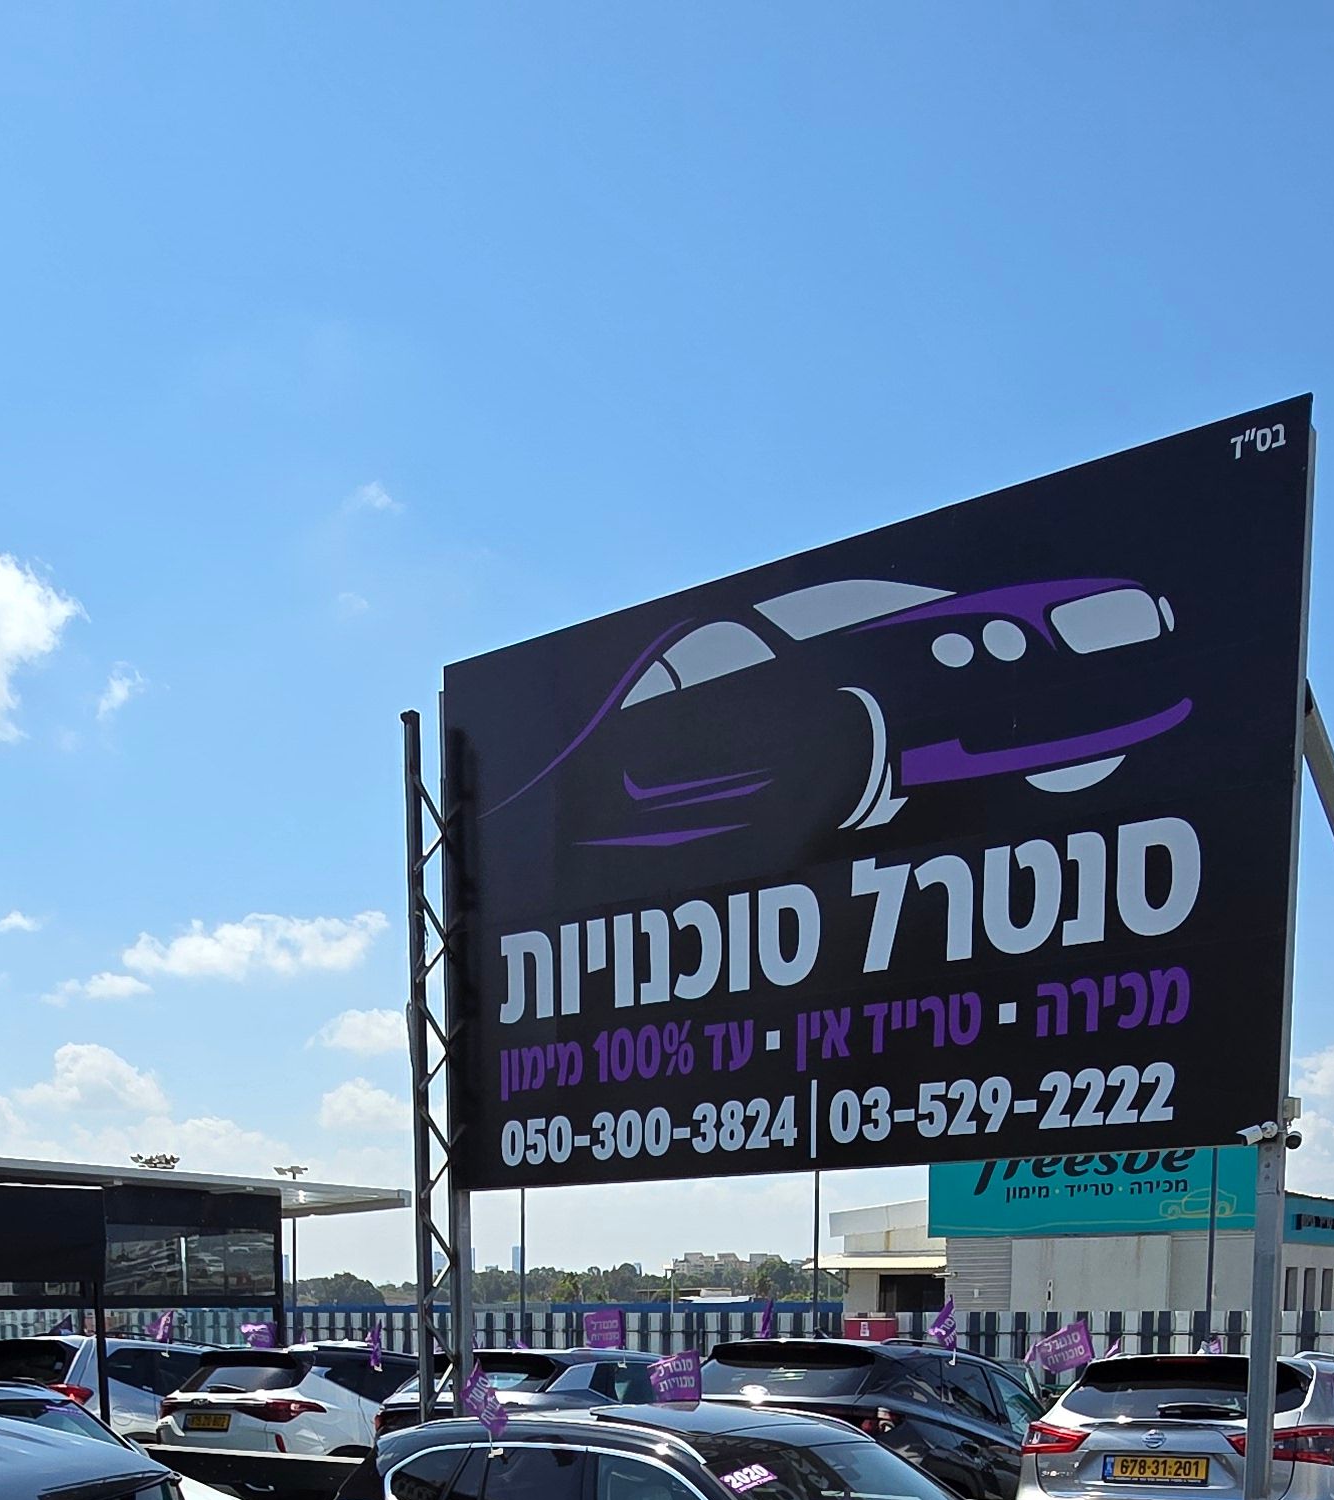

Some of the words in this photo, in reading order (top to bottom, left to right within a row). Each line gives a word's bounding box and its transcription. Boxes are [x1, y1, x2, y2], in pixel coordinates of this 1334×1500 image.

[850, 816, 1201, 973] סנטרל
[499, 883, 821, 1025] סוכנויות
[863, 990, 982, 1052] טרייד
[1035, 967, 1192, 1039] מכירה
[593, 1020, 695, 1086] 100%
[703, 1023, 756, 1070] עד
[795, 1007, 851, 1070] אין
[498, 1039, 583, 1102] מימון
[500, 1096, 798, 1168] 050-300-3824
[828, 1061, 1177, 1145] 03-529-2222
[1005, 1184, 1050, 1203] מימון
[1065, 1182, 1114, 1198] טרייד
[1130, 1179, 1188, 1195] מכירה
[724, 1464, 770, 1489] 2020
